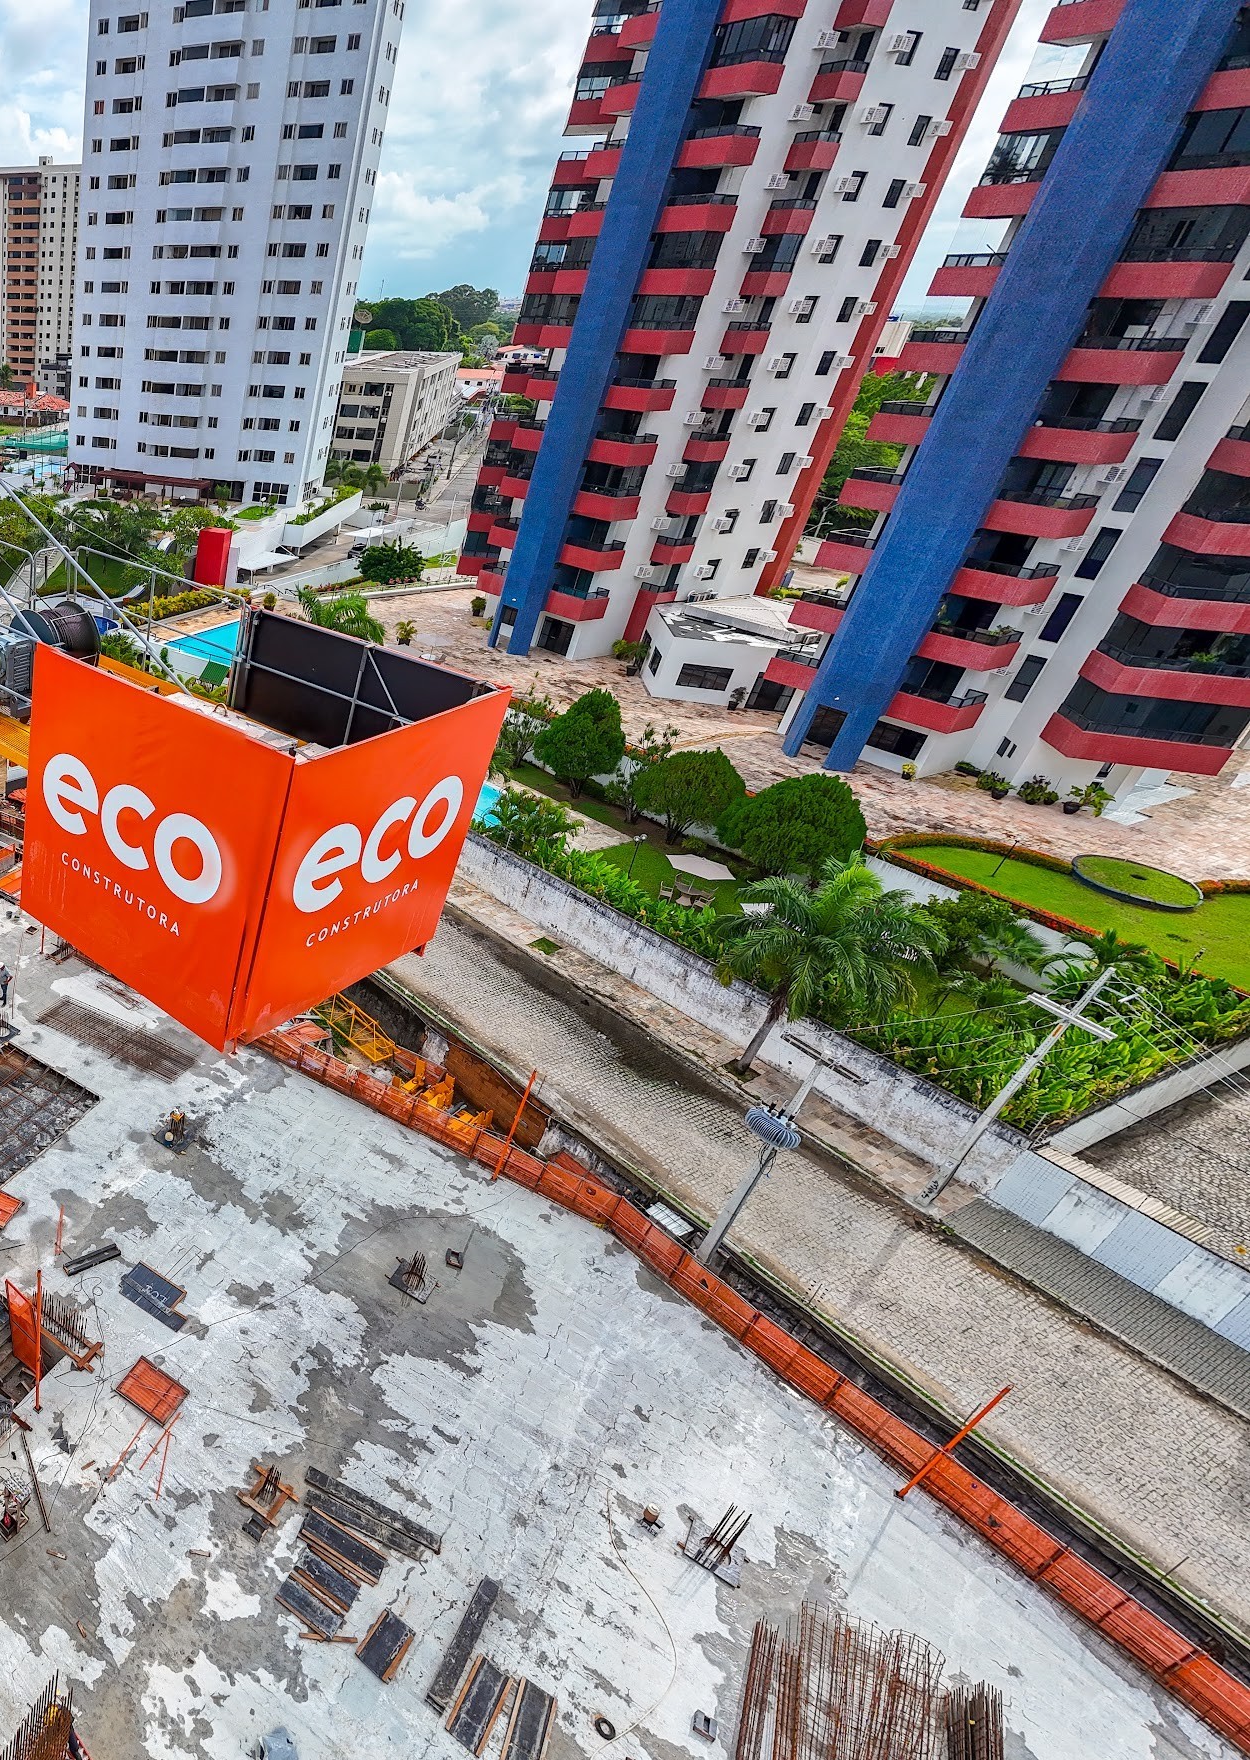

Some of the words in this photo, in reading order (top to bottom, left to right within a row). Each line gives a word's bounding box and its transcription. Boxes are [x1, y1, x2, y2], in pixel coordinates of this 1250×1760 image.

[42, 753, 223, 905] eco
[292, 775, 464, 913] eco
[61, 852, 181, 937] CONSTRUTORA
[306, 879, 419, 947] CONSTRUTORA
